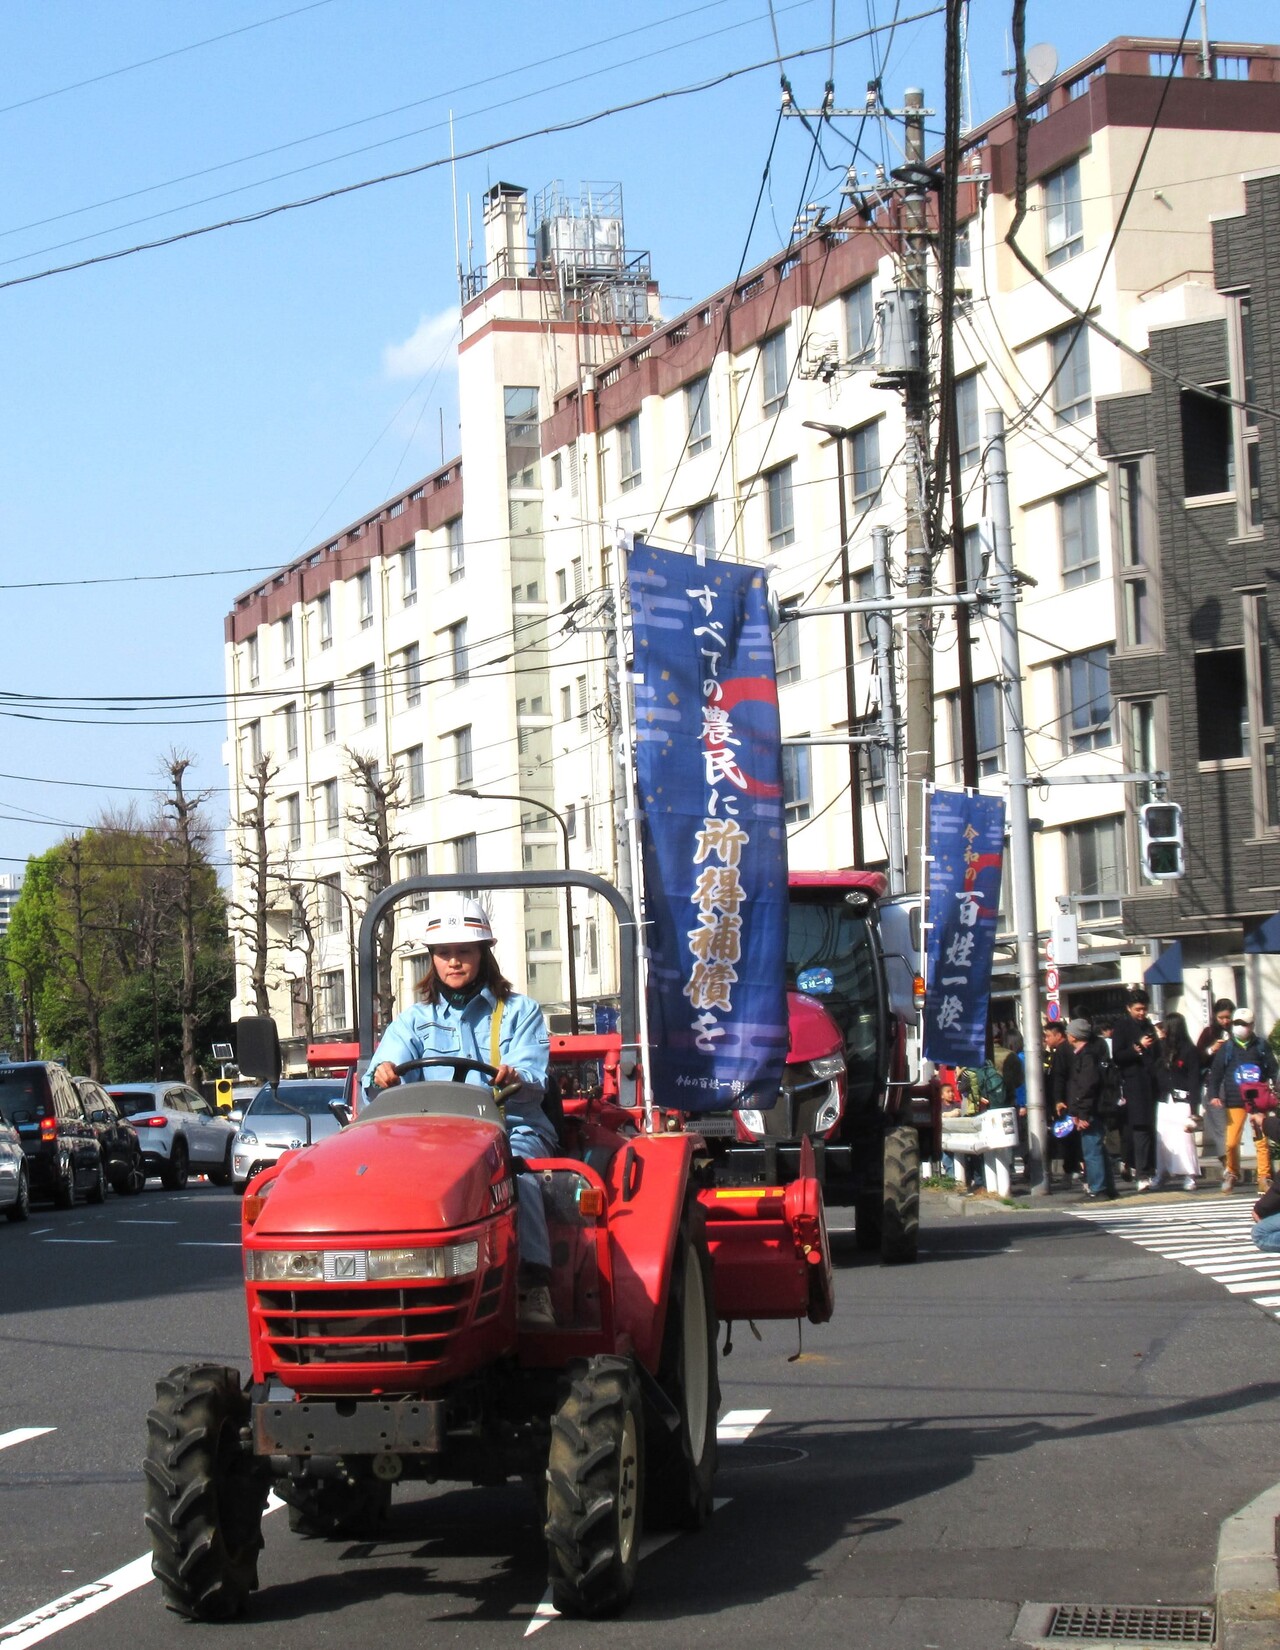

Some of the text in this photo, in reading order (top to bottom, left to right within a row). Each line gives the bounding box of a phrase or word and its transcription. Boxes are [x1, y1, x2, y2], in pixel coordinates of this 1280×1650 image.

[683, 584, 750, 1051] すべての農民に所得補償を
